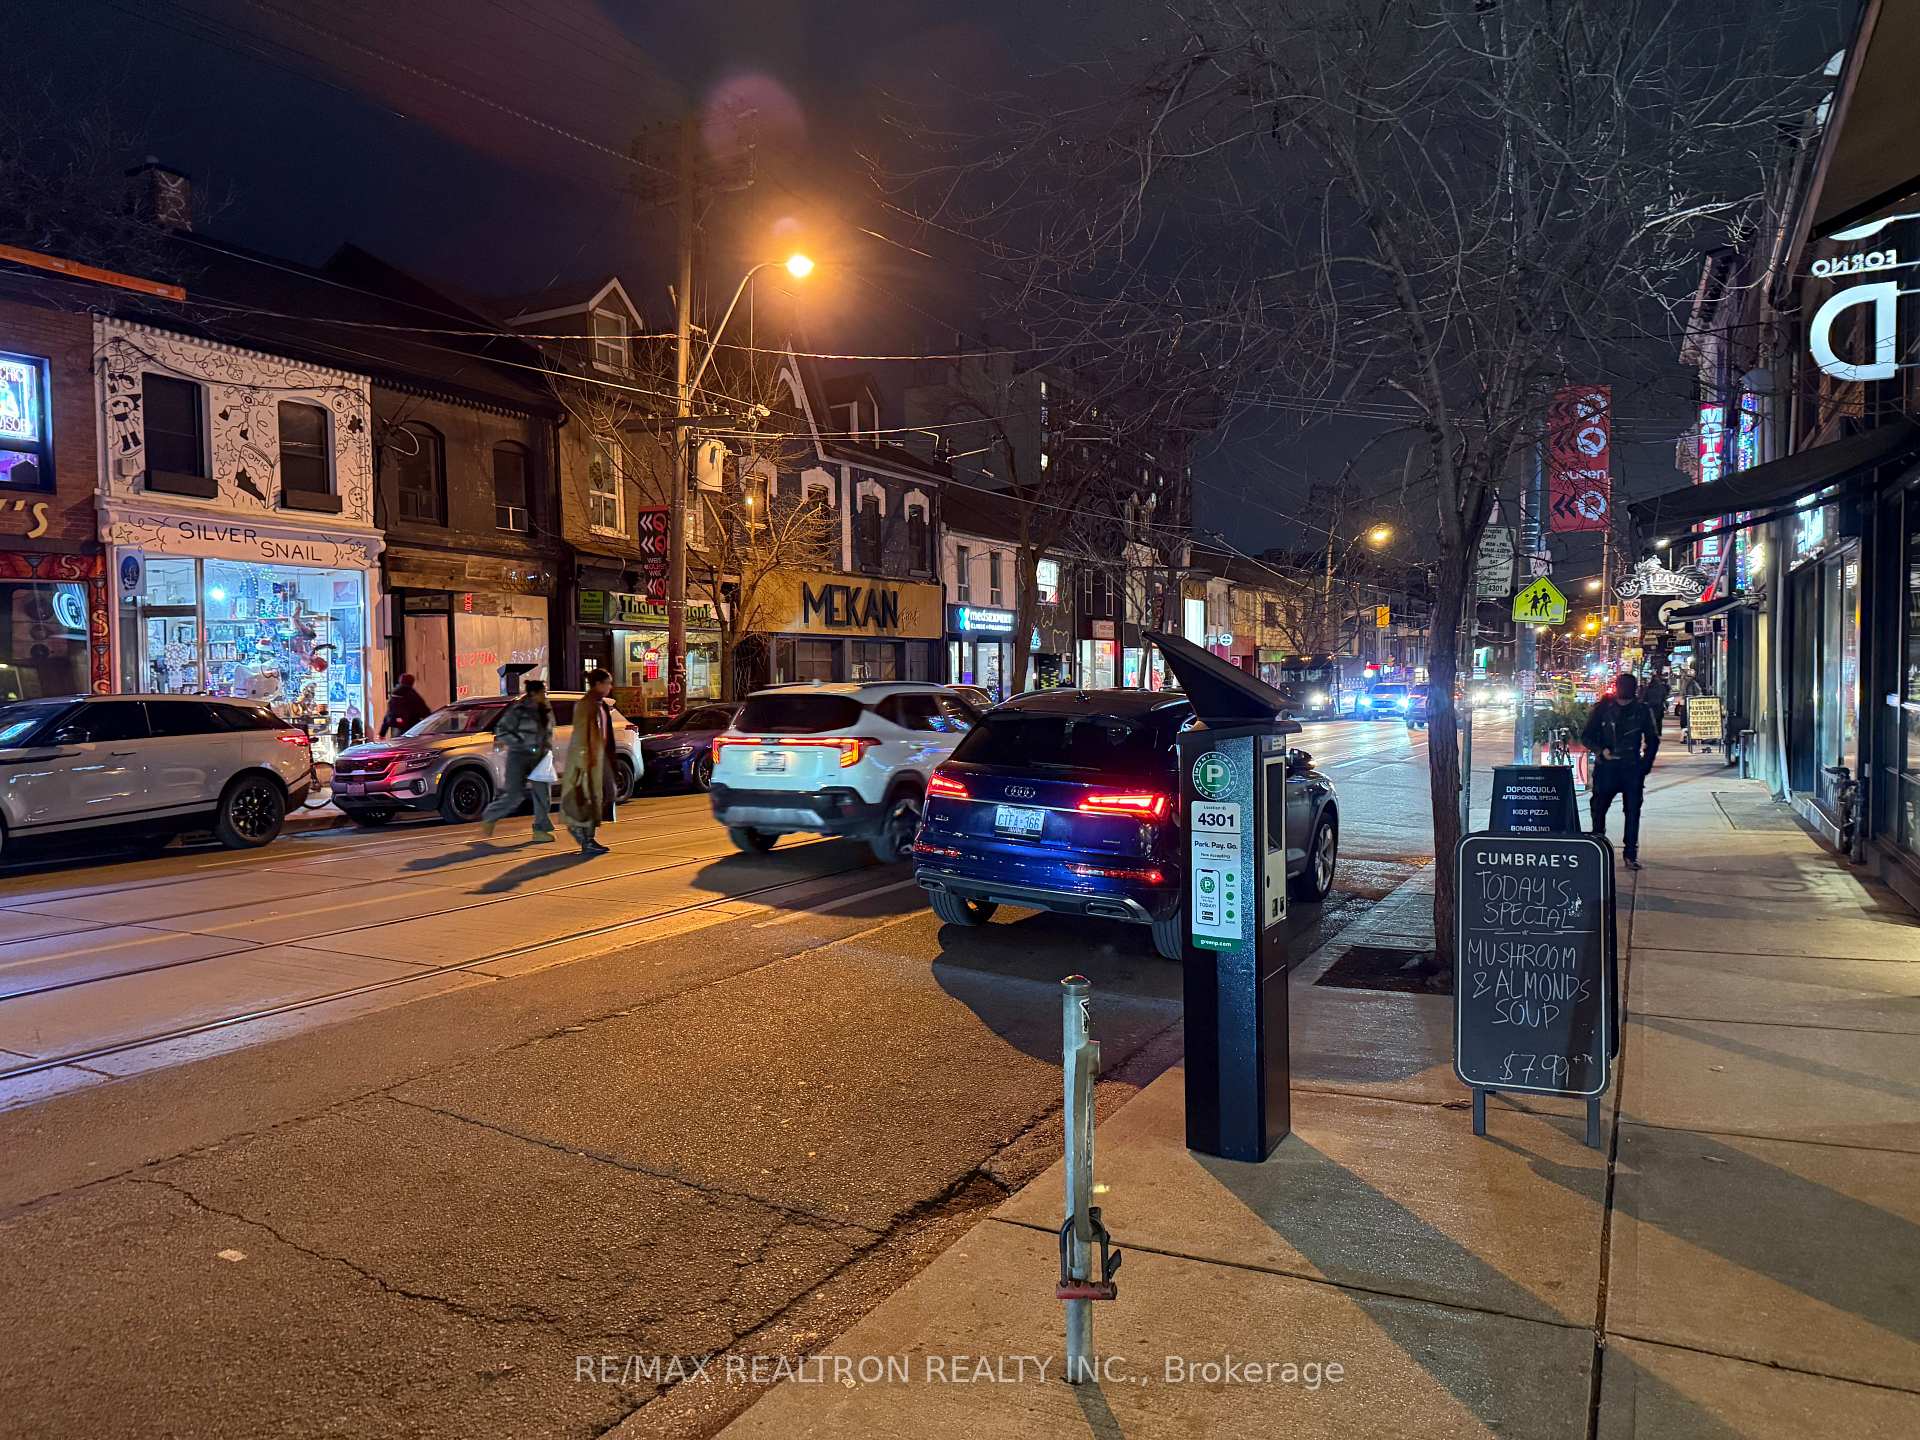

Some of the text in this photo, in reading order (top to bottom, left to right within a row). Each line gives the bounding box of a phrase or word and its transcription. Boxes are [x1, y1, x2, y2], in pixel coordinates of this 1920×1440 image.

[178, 521, 258, 545] SILVER
[260, 540, 323, 562] SNAIL
[1649, 573, 1705, 594] LEATHERS
[803, 581, 898, 630] MEKAN
[1206, 764, 1224, 783] P
[1197, 812, 1234, 827] 4301
[1211, 841, 1226, 851] Pay.
[1476, 852, 1579, 868] CUMBRAE'S
[1474, 870, 1571, 907] TODAY'S
[1483, 901, 1576, 929] SPECIAL
[1467, 937, 1577, 970] MUSHROOM
[1472, 968, 1592, 1003] & ALMONDS
[1491, 998, 1560, 1030] SOUP
[1499, 1052, 1570, 1087] $7.99
